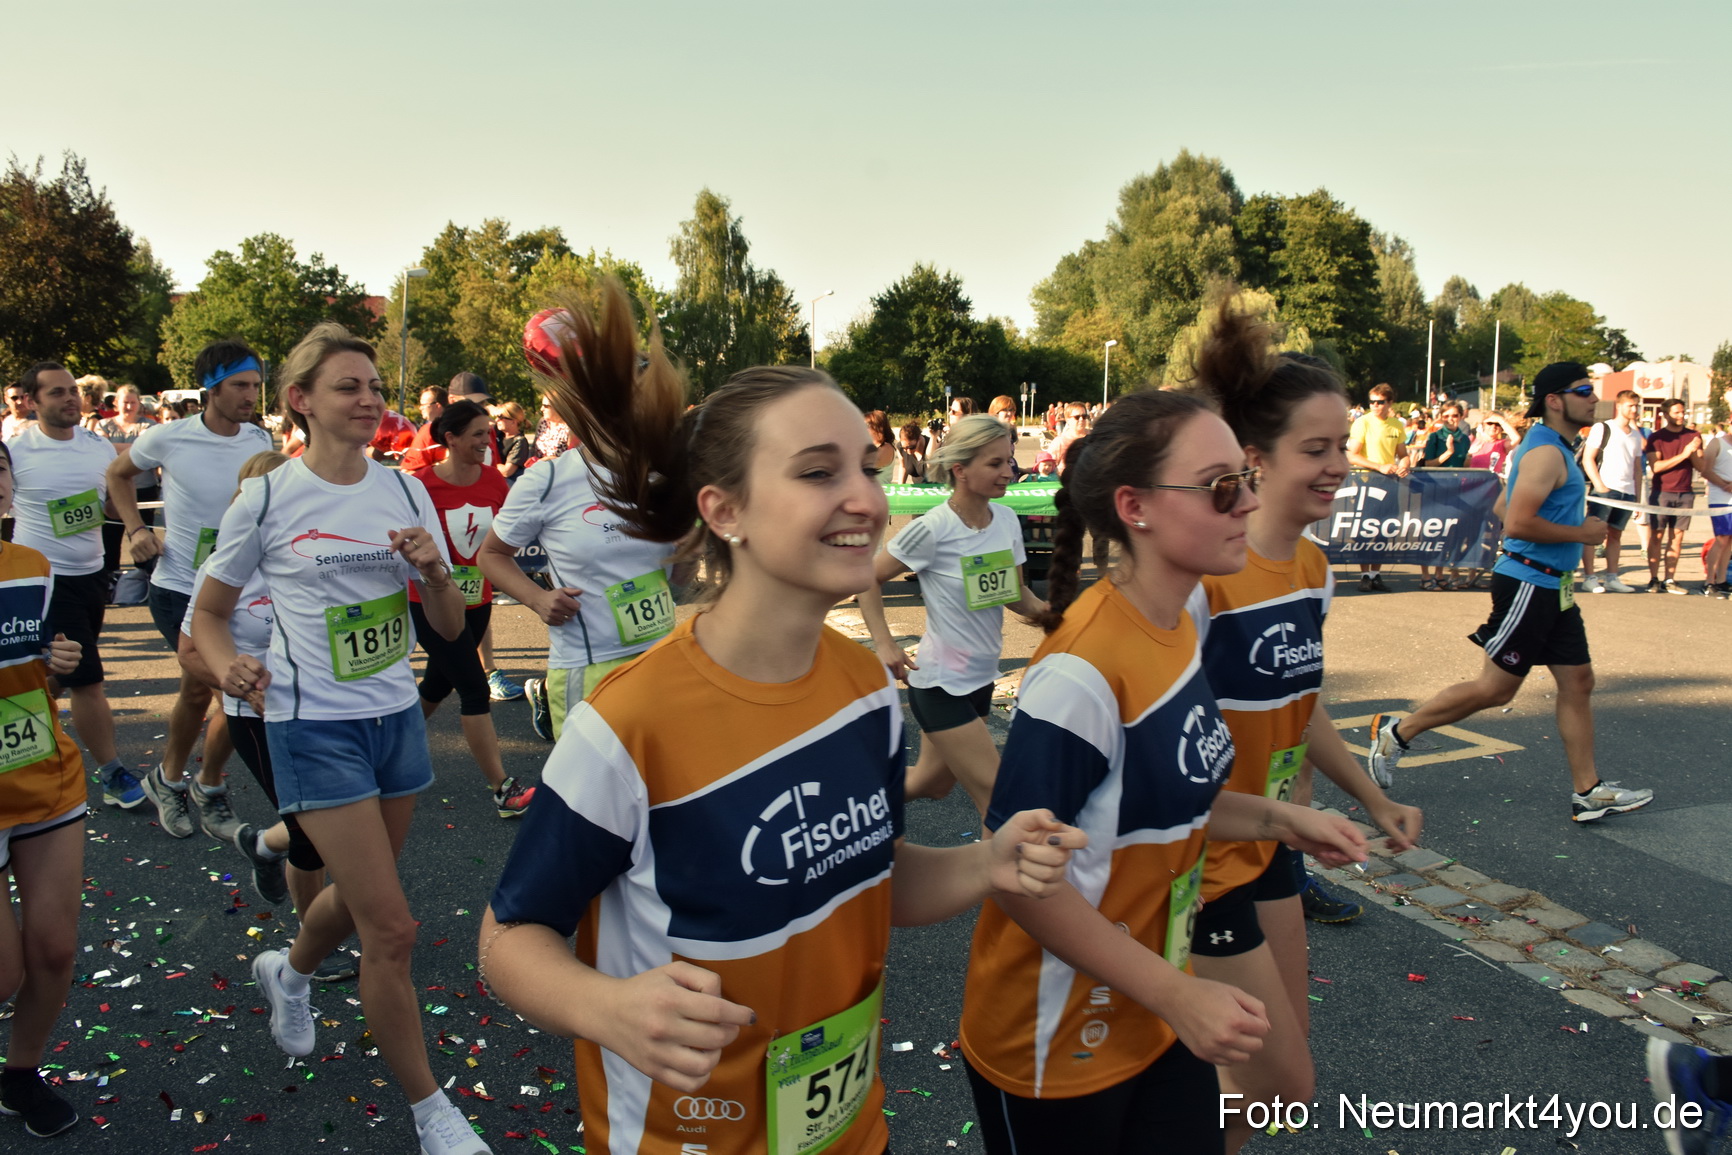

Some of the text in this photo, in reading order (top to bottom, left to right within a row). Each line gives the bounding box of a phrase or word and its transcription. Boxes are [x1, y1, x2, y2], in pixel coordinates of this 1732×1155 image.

[63, 505, 93, 525] 699
[1331, 511, 1458, 538] Fischer
[315, 549, 394, 566] Seniorenstift
[1340, 541, 1445, 552] AUTOMOBILE
[319, 562, 399, 580] am Tiroler Hof
[978, 570, 1007, 592] 697
[460, 580, 480, 594] 429
[625, 591, 670, 626] 1817
[344, 617, 402, 658] 1819
[781, 787, 890, 870] Fischer
[804, 820, 894, 884] AUTOMOBILE
[805, 1036, 871, 1120] 574
[676, 1125, 707, 1133] Audi
